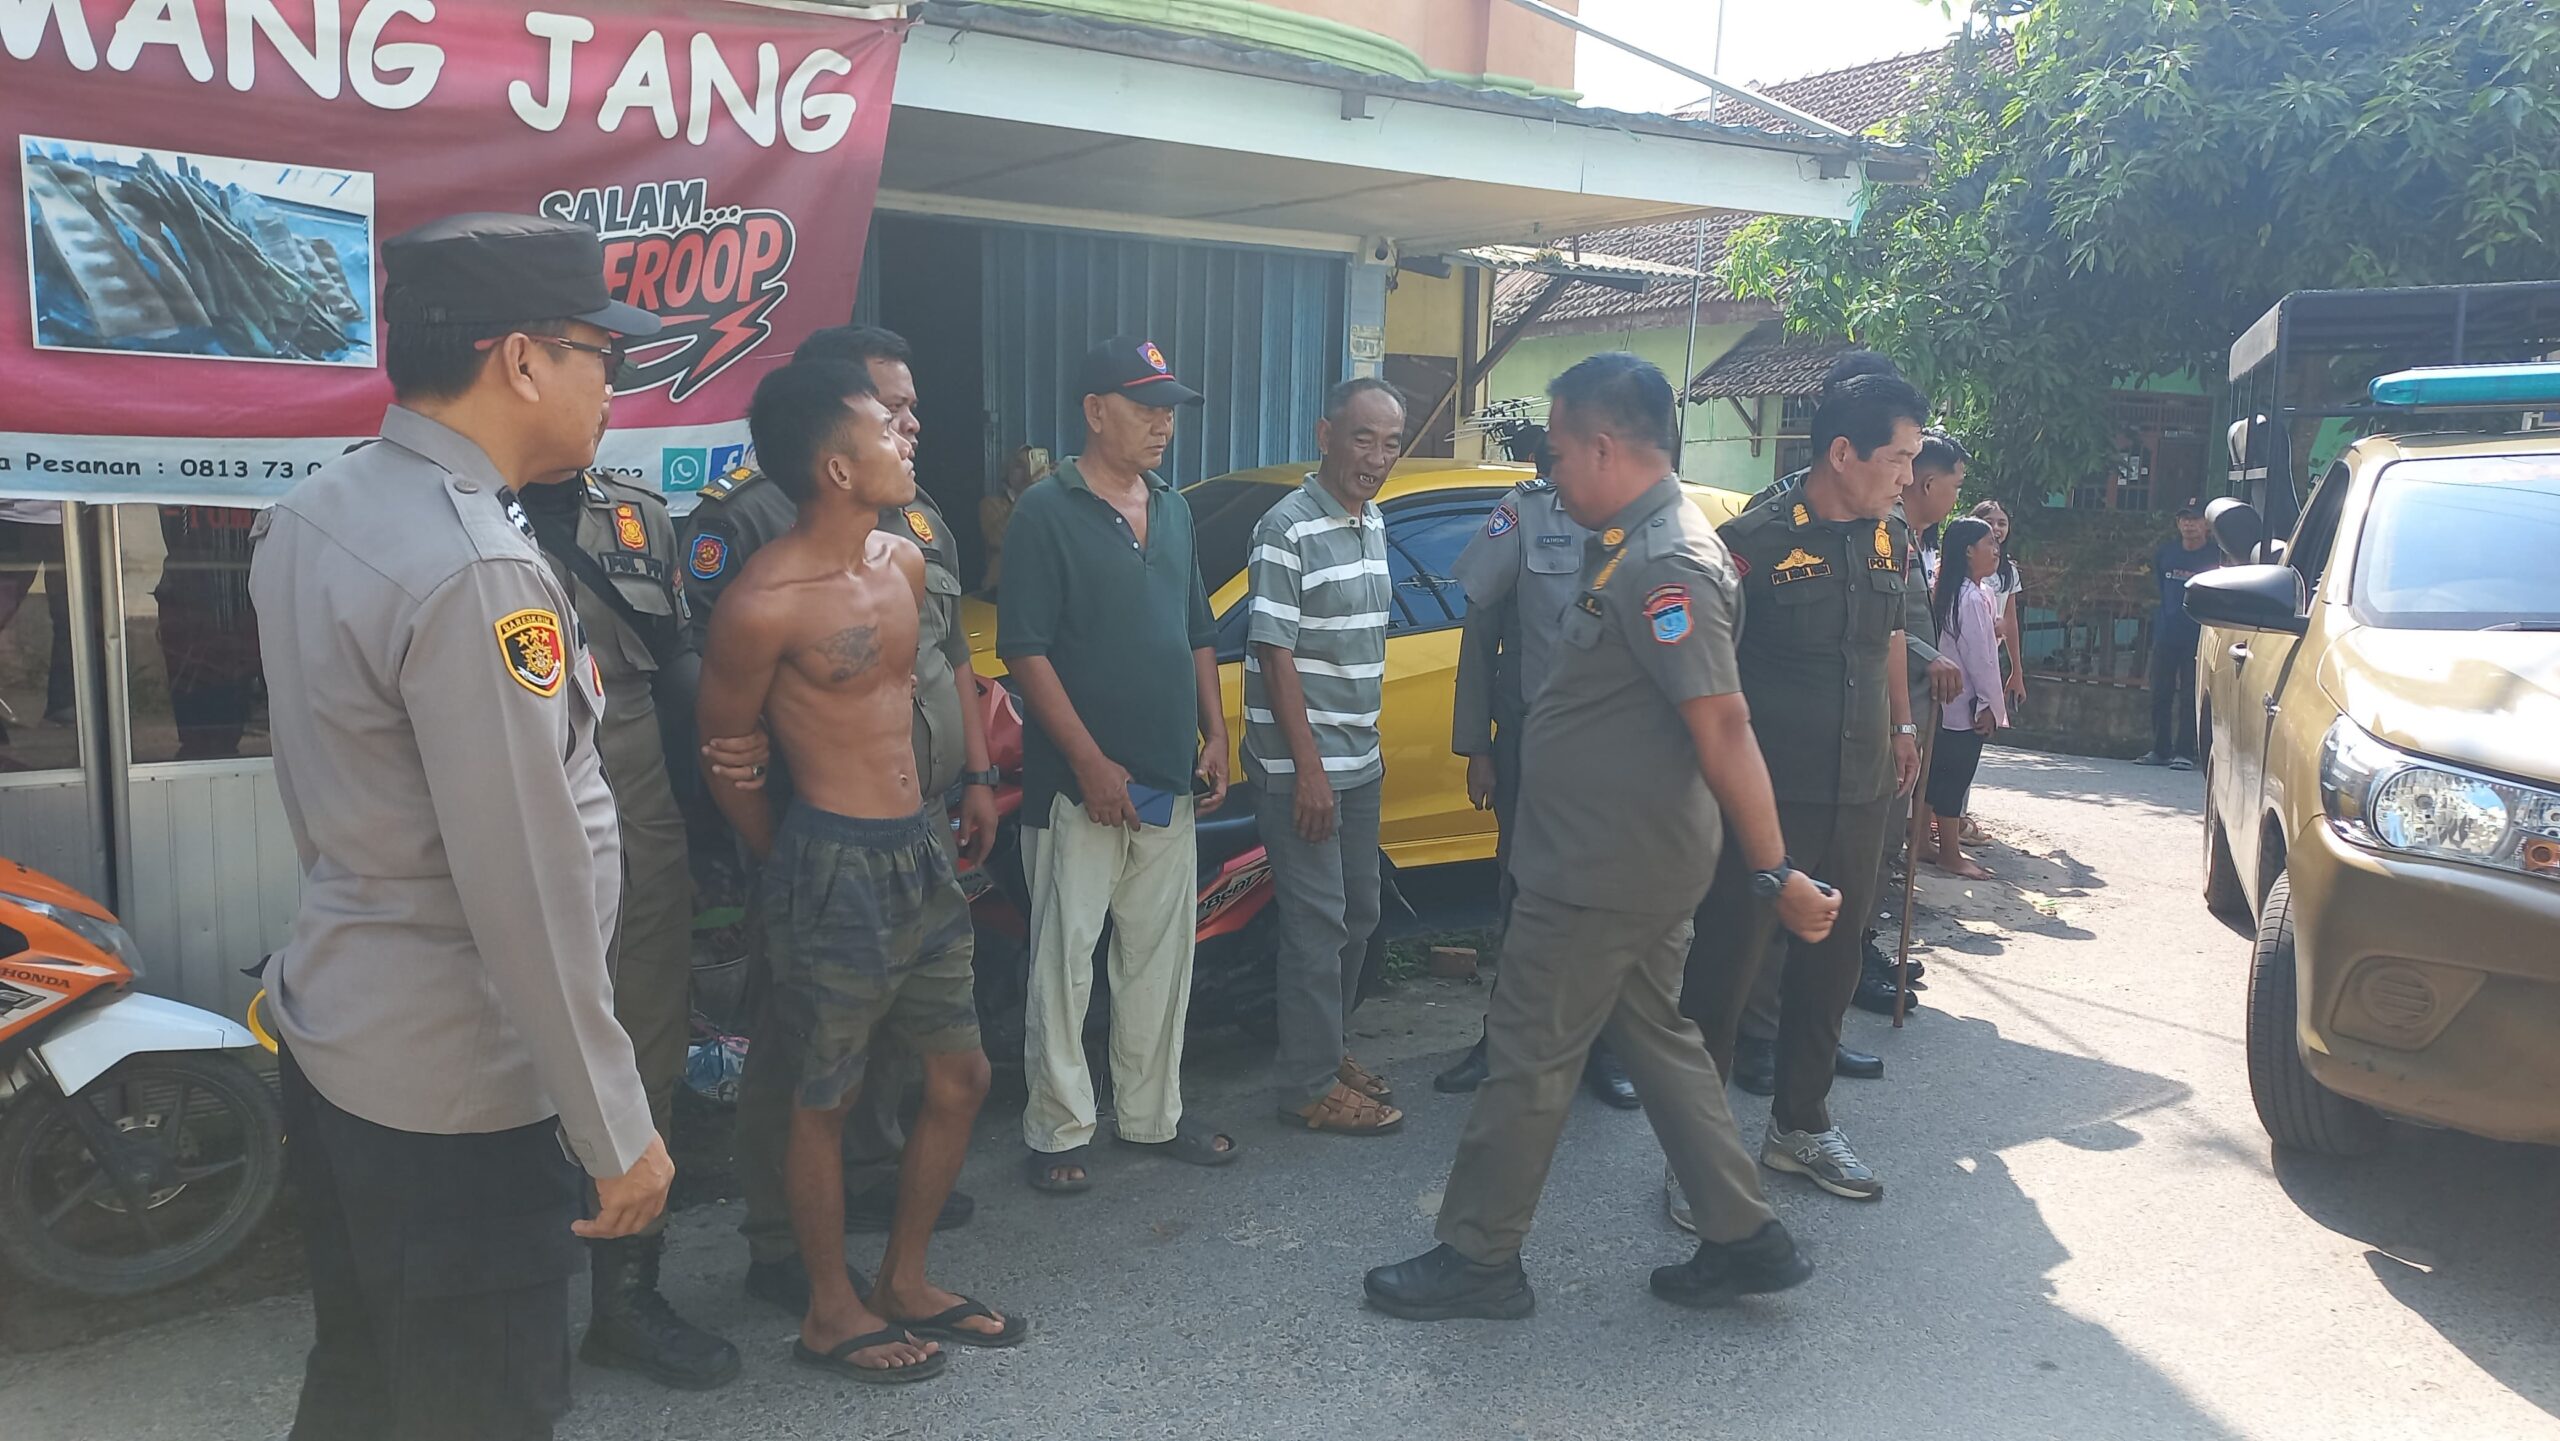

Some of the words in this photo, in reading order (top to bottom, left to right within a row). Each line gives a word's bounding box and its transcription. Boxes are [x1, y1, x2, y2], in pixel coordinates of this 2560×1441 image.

[508, 12, 856, 153] JANG
[25, 452, 141, 476] Pesanan
[180, 458, 248, 478] 0813
[262, 461, 294, 479] 73
[502, 615, 551, 632] BARESKRIM
[1, 967, 71, 989] HONDA
